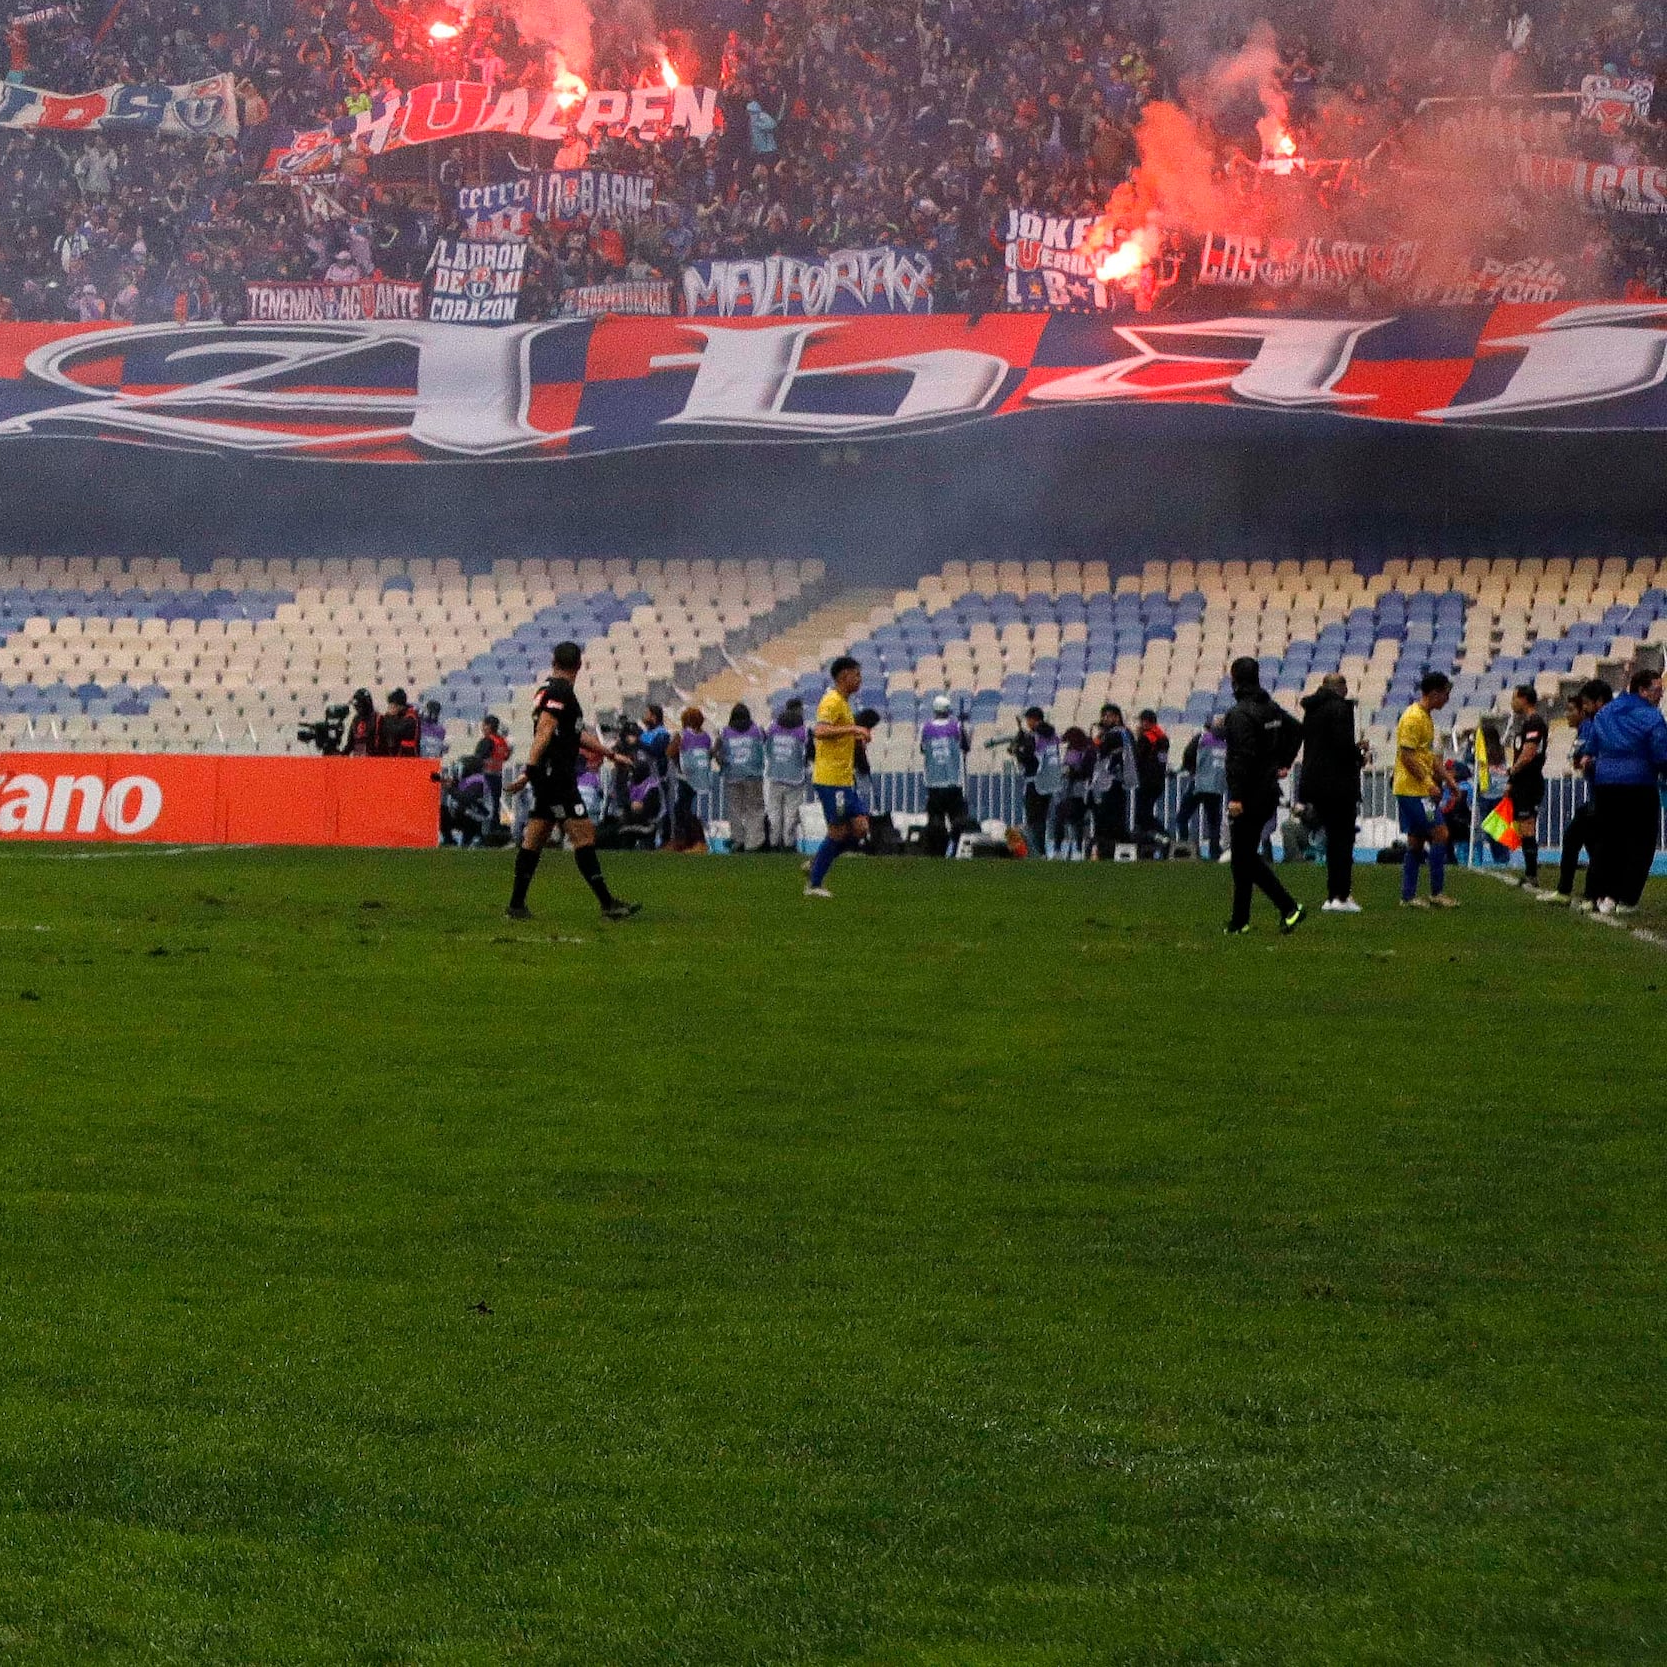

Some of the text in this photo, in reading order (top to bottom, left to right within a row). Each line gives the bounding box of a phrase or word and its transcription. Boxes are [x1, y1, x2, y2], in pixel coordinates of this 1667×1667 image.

[433, 267, 465, 294] DE
[494, 269, 523, 294] MI
[247, 284, 423, 321] TENEMOS AGUANTE
